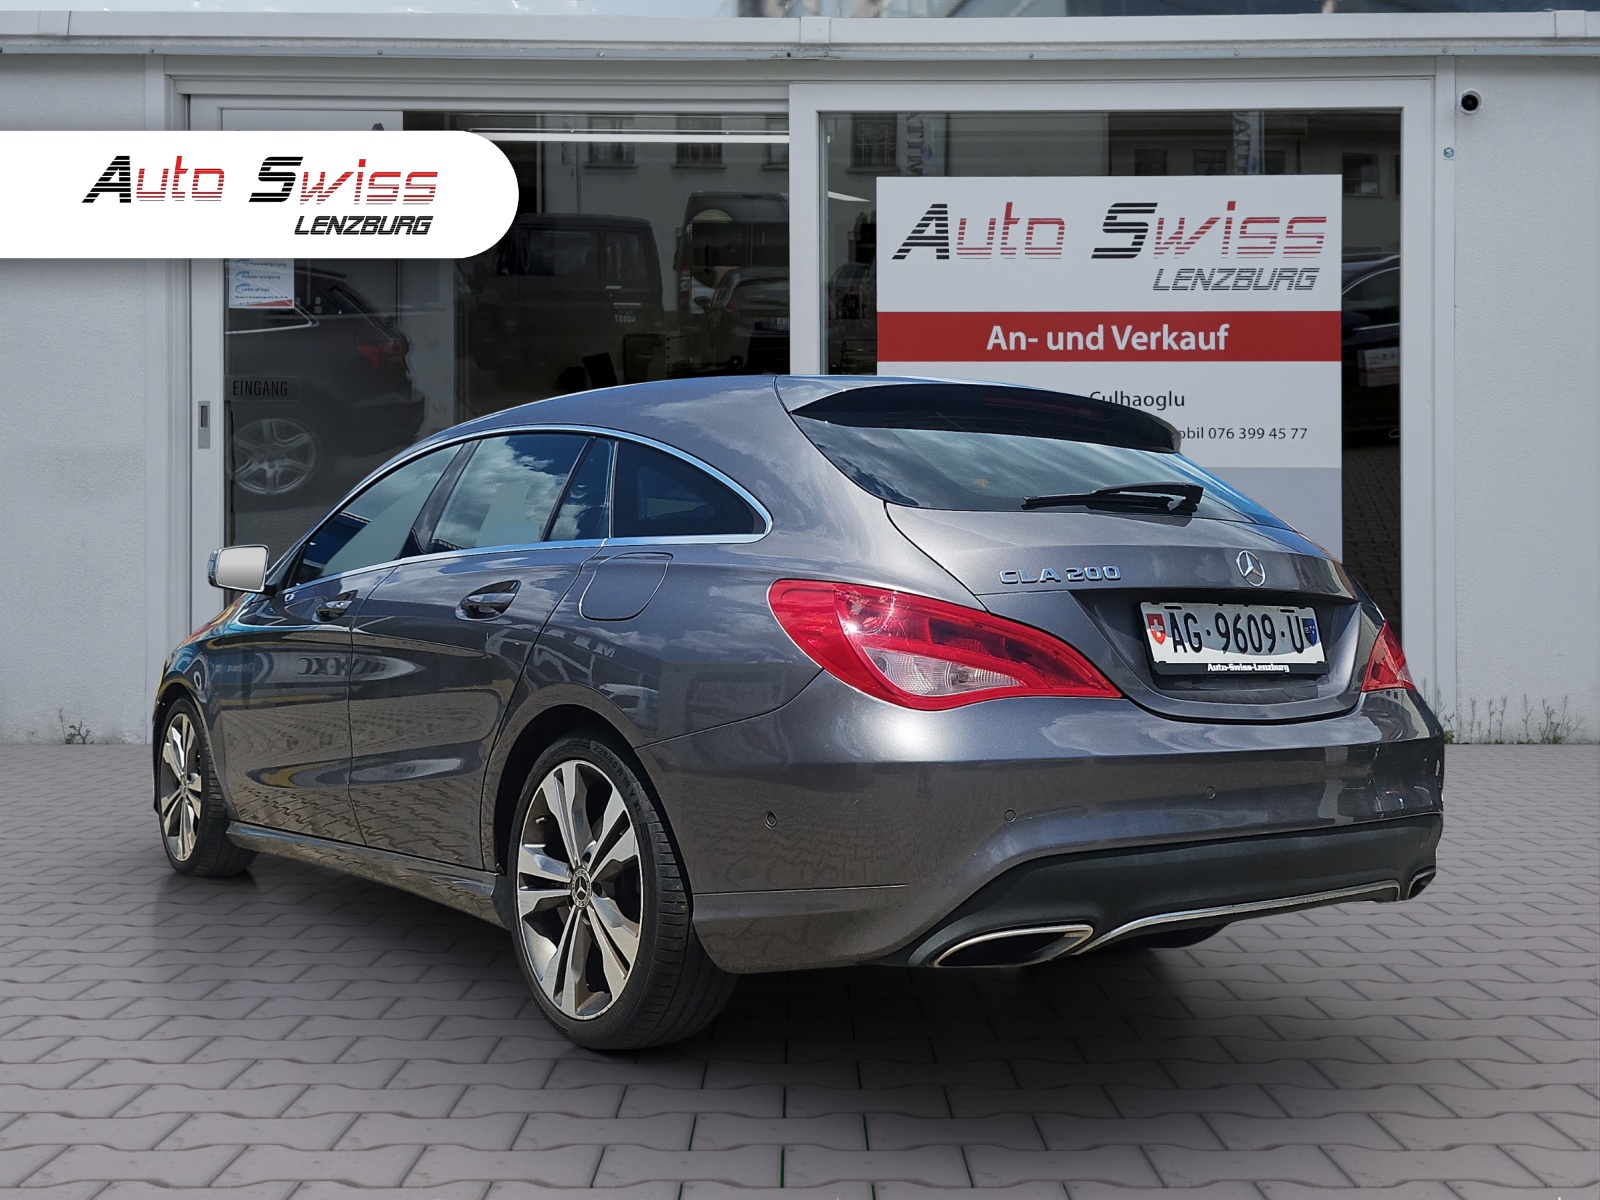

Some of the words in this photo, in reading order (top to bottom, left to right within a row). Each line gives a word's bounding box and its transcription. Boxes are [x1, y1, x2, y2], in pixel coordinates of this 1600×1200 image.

[891, 202, 1066, 260] Auto
[1091, 200, 1328, 260] Swiss
[1152, 267, 1320, 291] LENZBURG
[986, 324, 1039, 351] An-
[1047, 324, 1105, 351] und
[1111, 323, 1231, 351] Verkauf
[232, 380, 288, 397] EINGANG
[1179, 427, 1204, 440] obil
[1208, 427, 1235, 440] 076
[1238, 427, 1265, 440] 399
[1268, 427, 1286, 440] 45
[1290, 427, 1308, 440] 77
[998, 568, 1061, 585] CLA
[1066, 565, 1121, 583] 200
